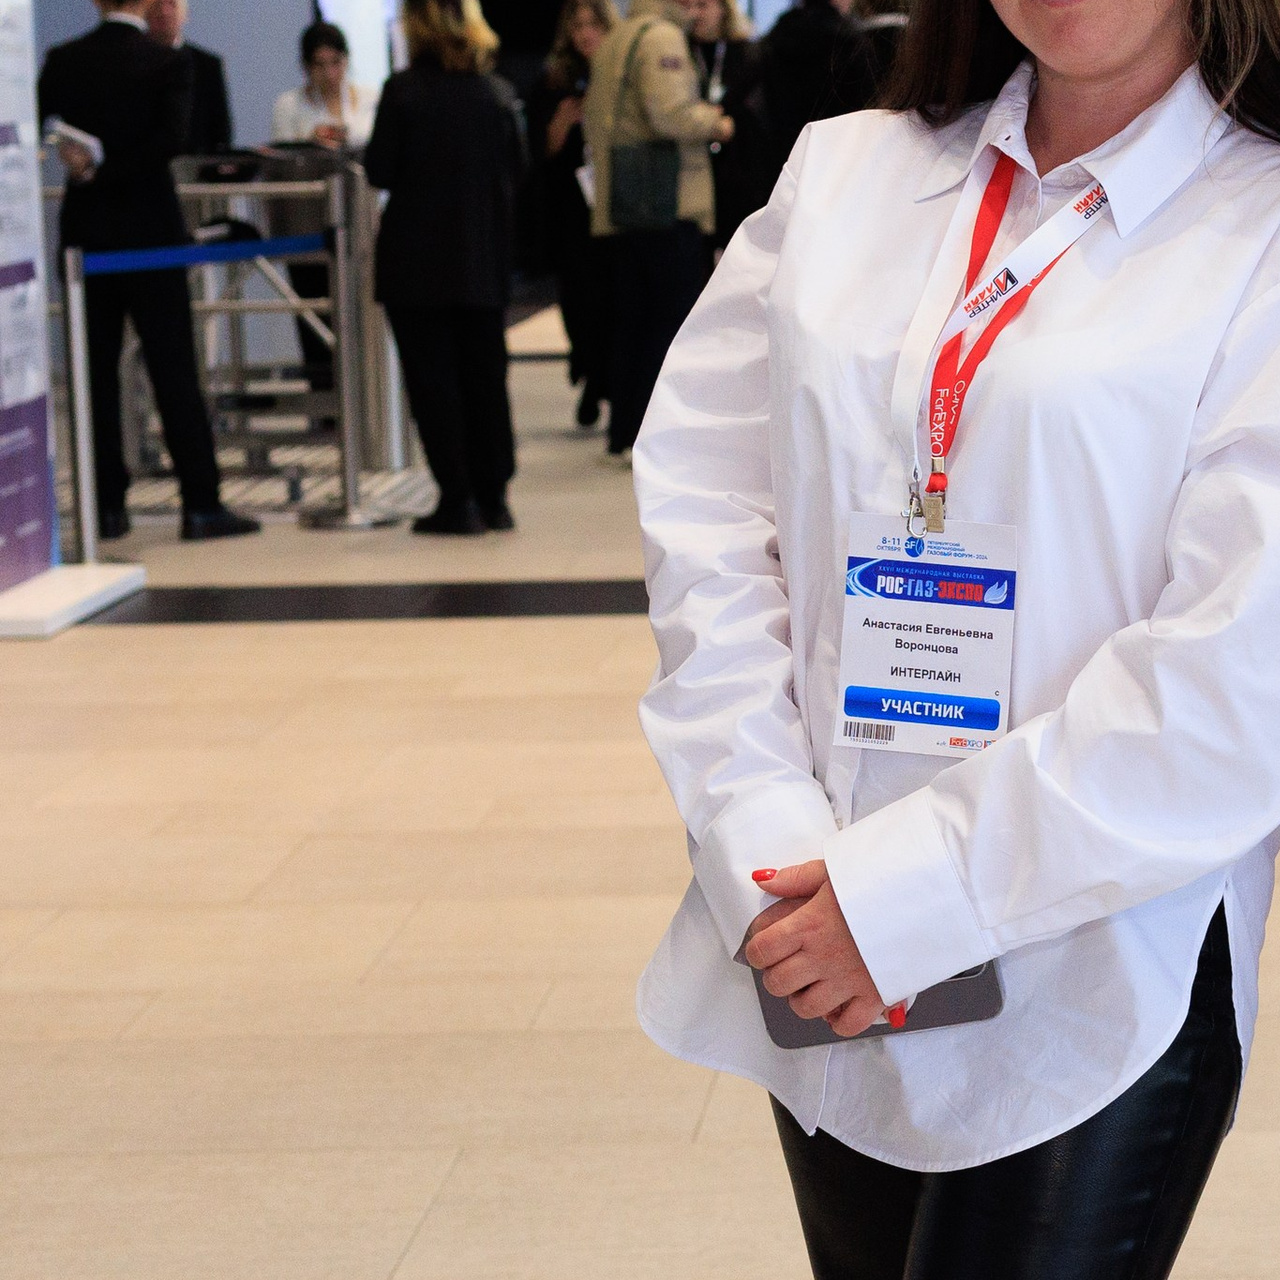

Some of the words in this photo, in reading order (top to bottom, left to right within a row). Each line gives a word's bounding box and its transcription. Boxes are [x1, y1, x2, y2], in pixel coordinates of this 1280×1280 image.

[968, 289, 1002, 319] ИНТЕР
[930, 387, 950, 458] FarEXPO
[876, 575, 984, 603] РОС-ГАЗ-ЭКСПО
[862, 617, 922, 633] Анастасия
[925, 623, 994, 640] Евгеньевна
[895, 638, 959, 655] Воронцова
[890, 666, 961, 683] ИНТЕРЛАЙН
[880, 697, 965, 720] УЧАСТНИК
